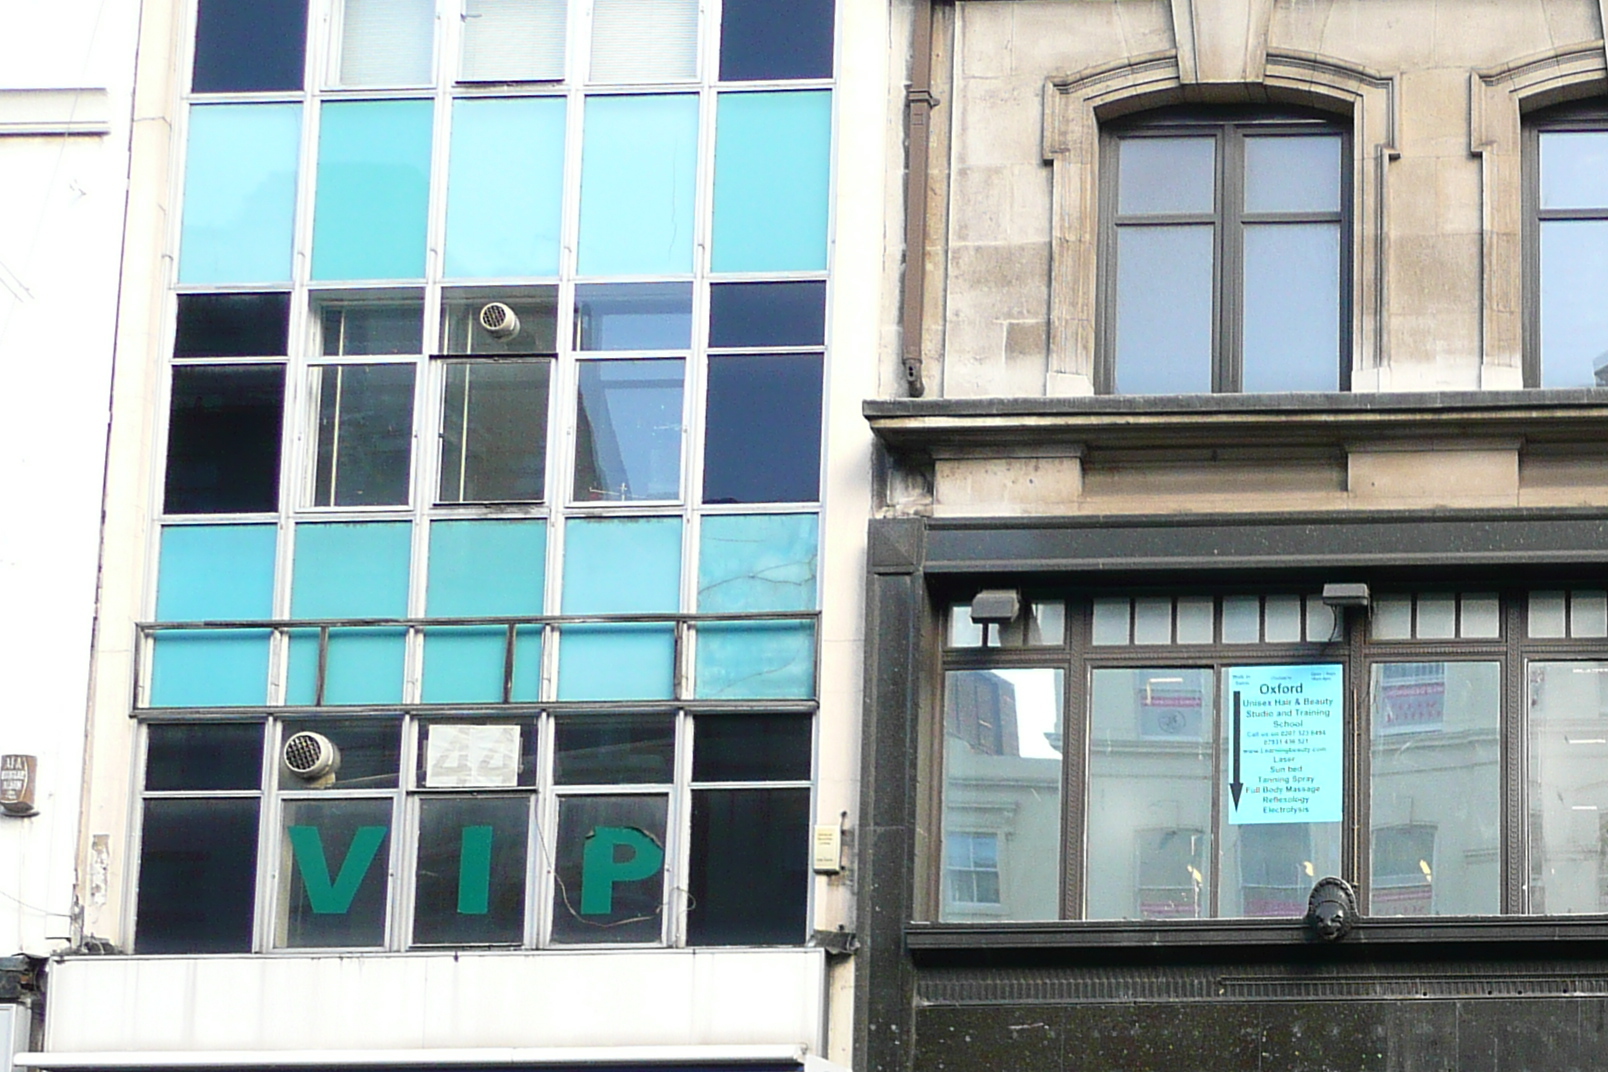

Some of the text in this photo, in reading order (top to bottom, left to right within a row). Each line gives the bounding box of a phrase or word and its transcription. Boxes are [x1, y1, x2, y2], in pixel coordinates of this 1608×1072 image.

[1259, 682, 1303, 695] Oxford
[1243, 698, 1333, 707] Unisex Hair & Beauty
[1246, 709, 1330, 718] Studio and Training
[1273, 720, 1303, 728] School
[1285, 786, 1320, 794] Massage
[288, 824, 664, 915] VIP
